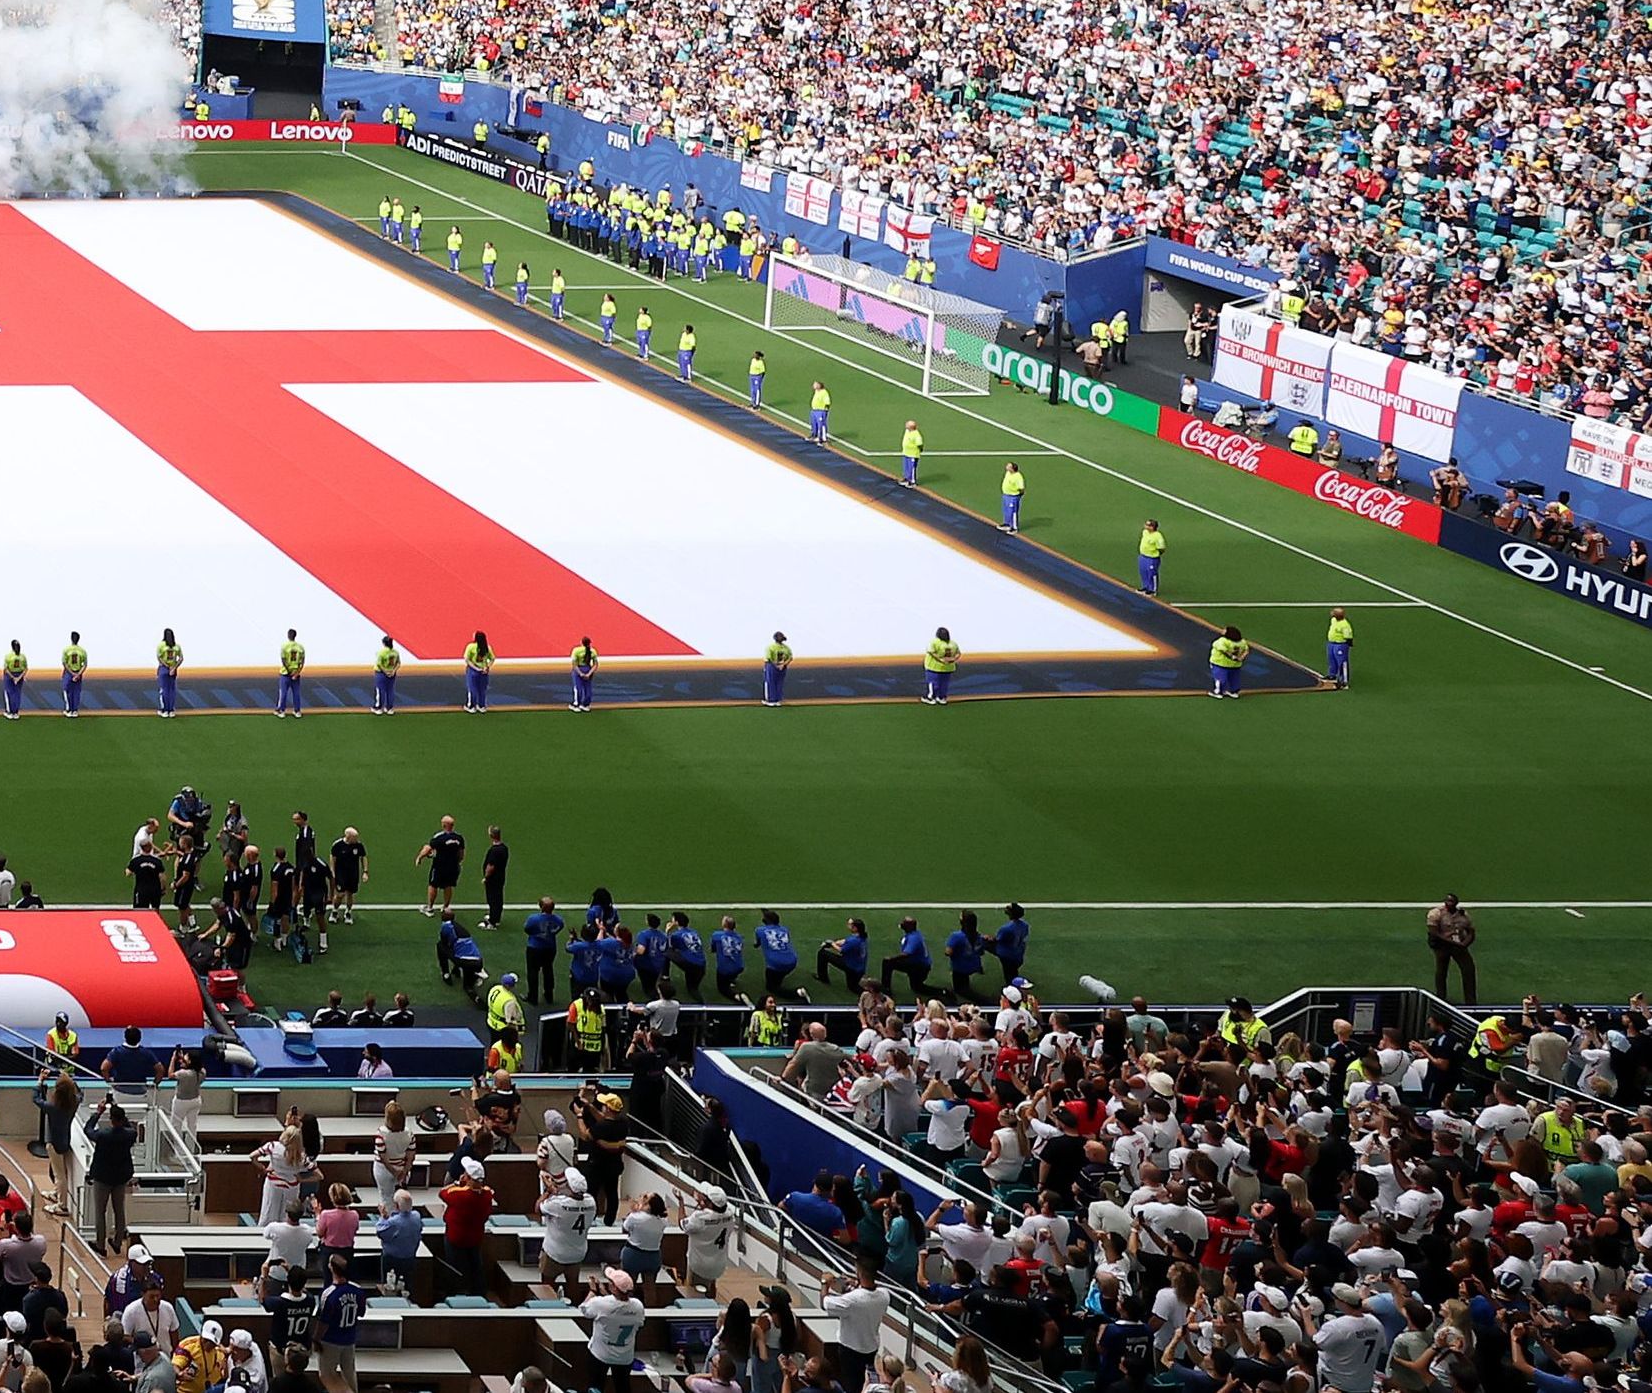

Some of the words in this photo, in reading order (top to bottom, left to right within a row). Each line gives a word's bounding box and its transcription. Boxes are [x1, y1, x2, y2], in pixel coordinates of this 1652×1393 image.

[270, 120, 354, 142] Lenovo
[607, 130, 630, 151] FIFA
[407, 134, 431, 156] ADI
[432, 143, 506, 180] PREDICTSTREET
[515, 169, 548, 197] QATA
[1169, 253, 1190, 269] FIFA
[1190, 259, 1224, 279] WORLD
[1224, 269, 1244, 284] CUP
[1244, 276, 1270, 292] 202
[1219, 338, 1240, 356] WEST
[1242, 345, 1291, 374] BROMWICH
[982, 343, 1114, 417] aramco
[1331, 374, 1411, 413] CAERNARFON
[1415, 403, 1455, 427] TOWN
[573, 1214, 585, 1235] 4
[715, 1228, 728, 1248] 4
[287, 1315, 308, 1335] 10
[340, 1305, 357, 1327] 10
[1363, 1339, 1376, 1364] 7
